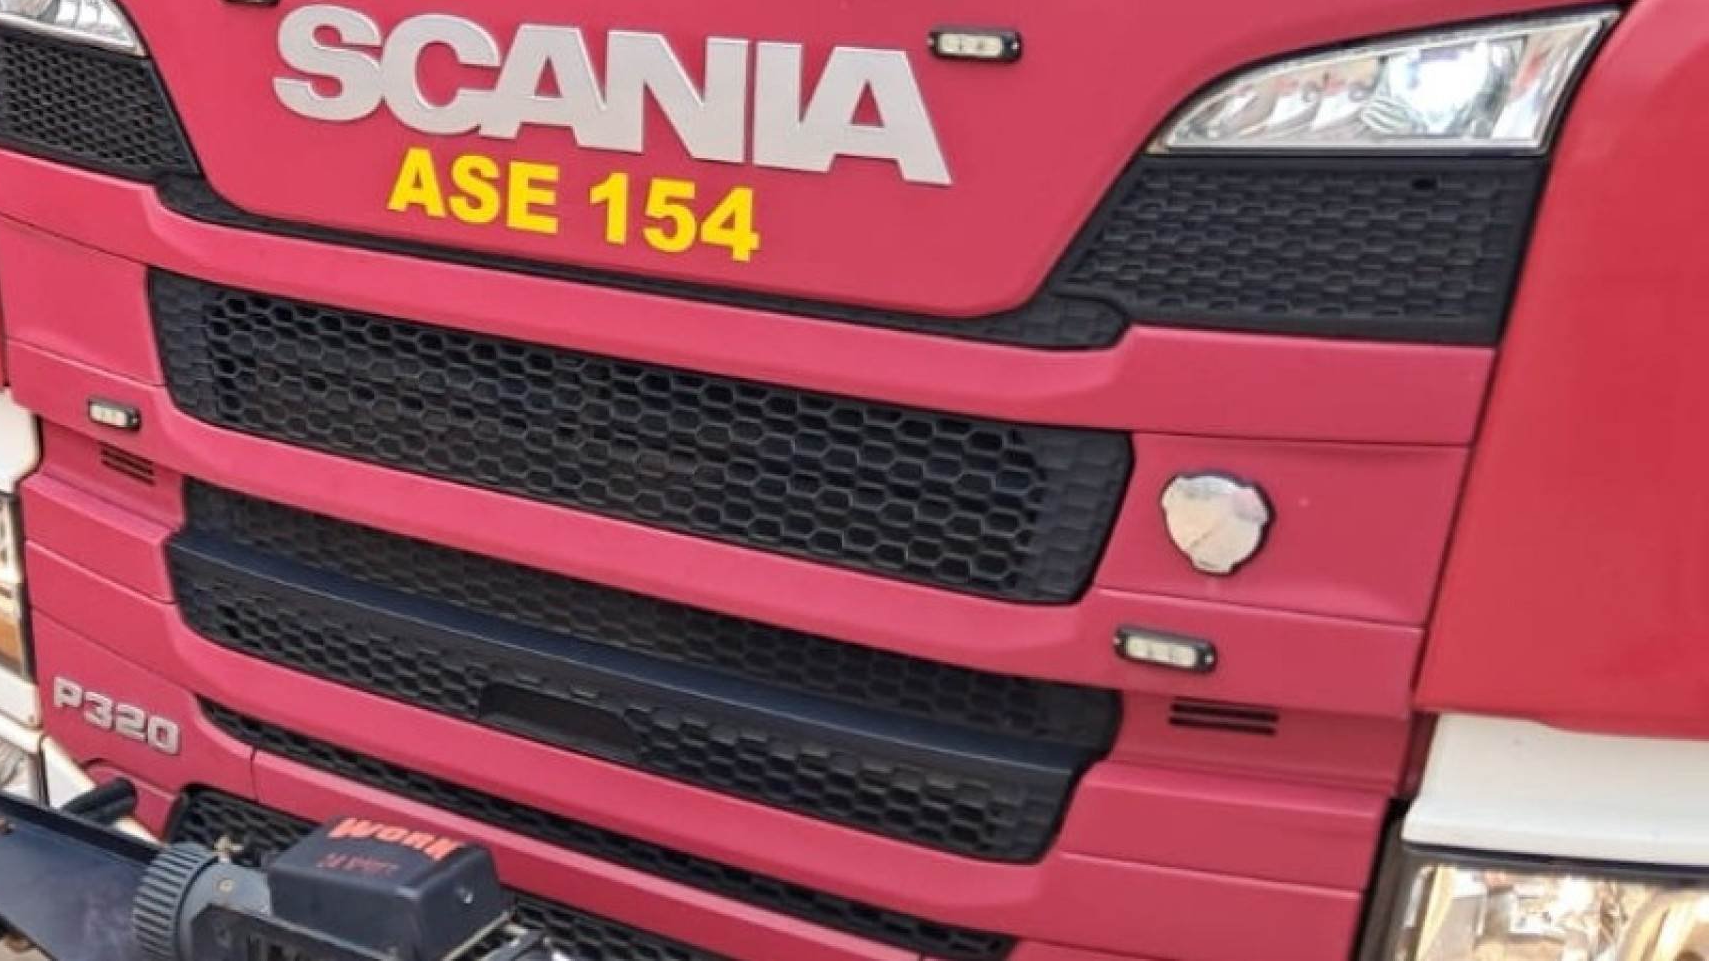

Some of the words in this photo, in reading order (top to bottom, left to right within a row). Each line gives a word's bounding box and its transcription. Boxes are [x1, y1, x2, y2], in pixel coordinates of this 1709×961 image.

[273, 3, 952, 186] SCANIA
[388, 147, 559, 234] ASE
[590, 172, 760, 262] 154
[53, 676, 182, 755] P320
